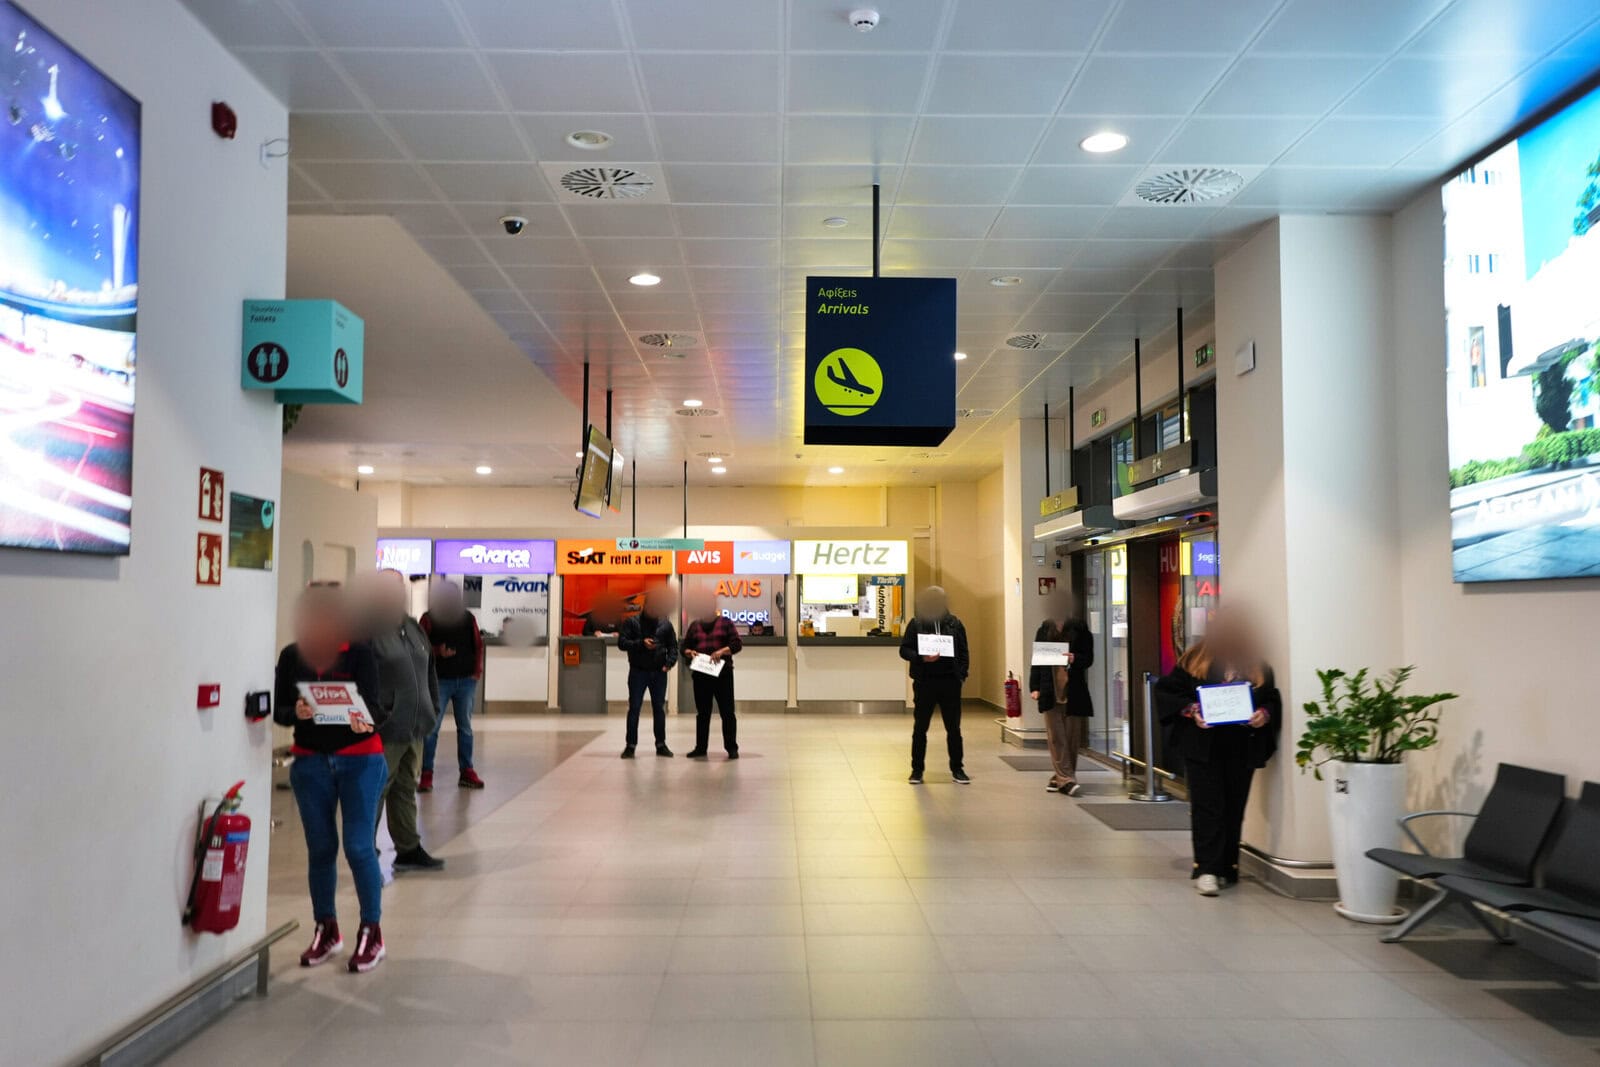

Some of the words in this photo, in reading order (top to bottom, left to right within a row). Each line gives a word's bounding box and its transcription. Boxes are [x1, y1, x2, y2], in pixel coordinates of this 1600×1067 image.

[818, 287, 857, 299] Αφίξεις
[817, 303, 869, 315] Arrivals
[610, 553, 632, 565] rent
[635, 555, 641, 565] a
[645, 555, 663, 565] car
[687, 550, 721, 564] AVIS
[752, 550, 786, 563] Budget
[813, 543, 889, 565] Hertz
[714, 579, 761, 598] AVIS
[722, 608, 769, 625] Budget
